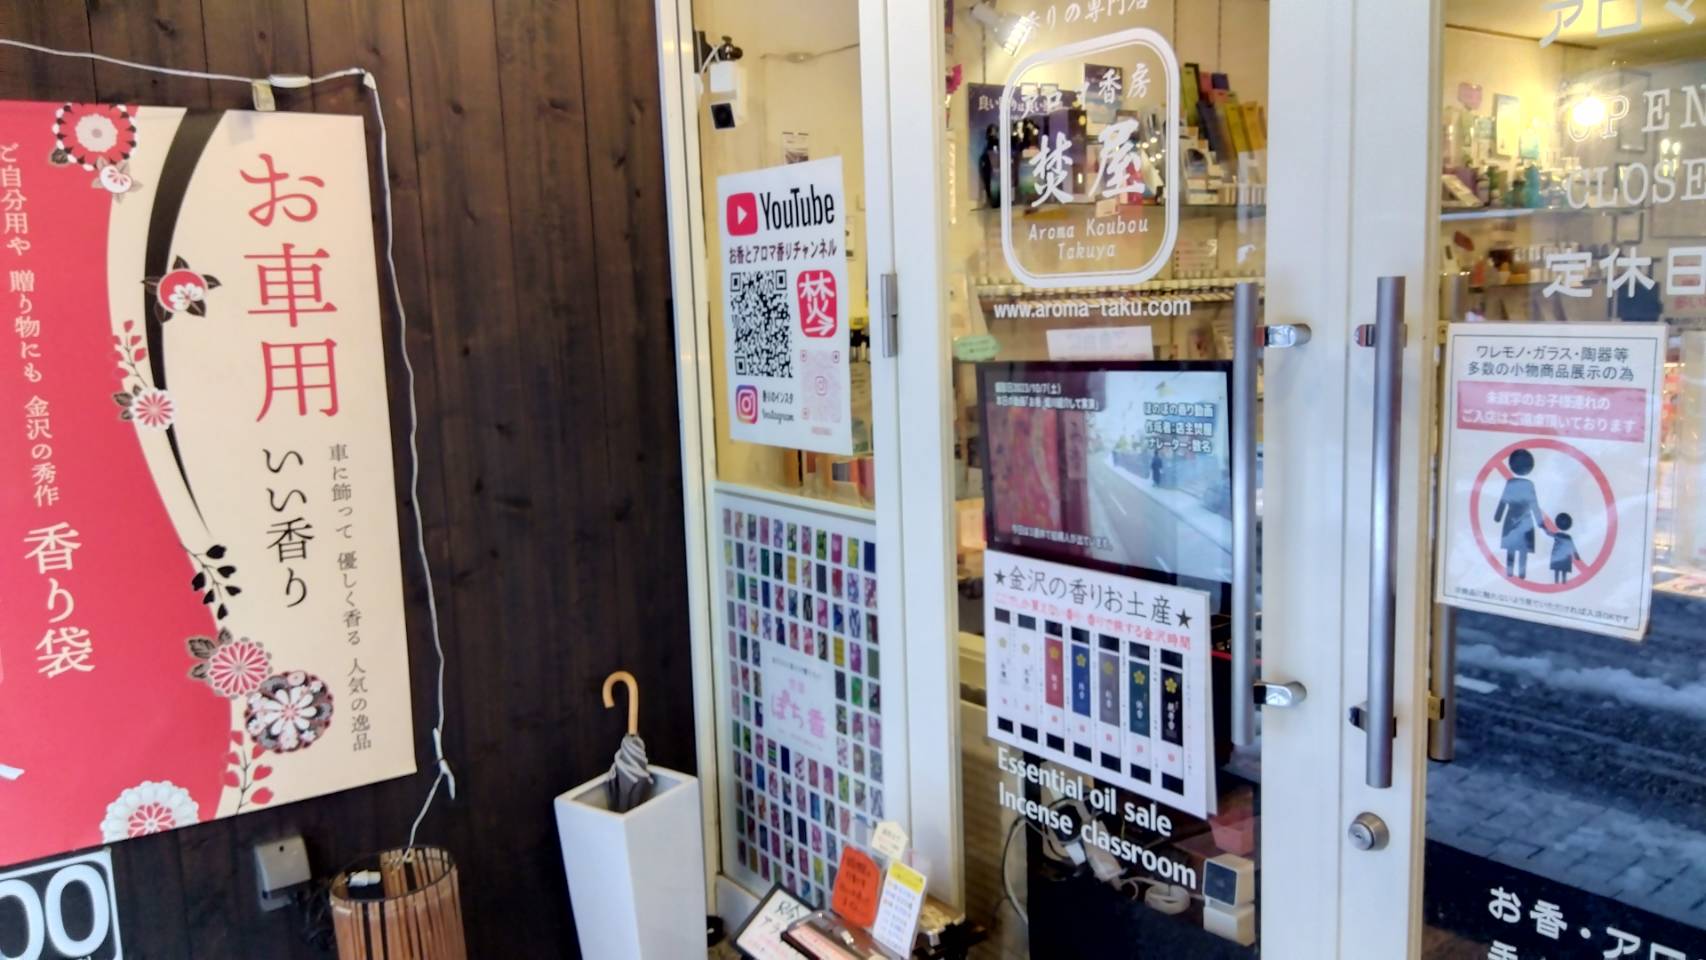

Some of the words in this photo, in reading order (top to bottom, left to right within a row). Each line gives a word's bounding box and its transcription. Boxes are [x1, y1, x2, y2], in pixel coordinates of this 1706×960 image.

[0, 142, 31, 256] ご自分用や
[759, 184, 835, 231] YouTube
[1029, 223, 1075, 241] Aroma
[1086, 216, 1149, 237] Koubou
[239, 152, 339, 423] お車用
[729, 238, 837, 265] お香とアロマ香りチャンネル
[1057, 241, 1116, 261] Takuya
[1542, 246, 1706, 299] 定休日
[9, 269, 42, 383] 贈り物にも
[993, 297, 1191, 319] www.aroma-taku.com
[1475, 345, 1630, 364] ワレモノ・ガラス・陶器等
[1467, 361, 1635, 382] 多数の小物商品展示の為
[24, 395, 59, 508] 金沢の秀作
[329, 443, 353, 540] 車に飾って
[261, 448, 314, 608] いい香り
[23, 521, 96, 679] 香り袋
[337, 550, 362, 646] 優しく香る
[347, 657, 373, 751] 人気の逸品
[997, 746, 1084, 802] Essential
[1089, 787, 1117, 816] oil
[1123, 801, 1173, 838] sale
[998, 782, 1074, 836] Incense
[1080, 820, 1197, 890] classroom
